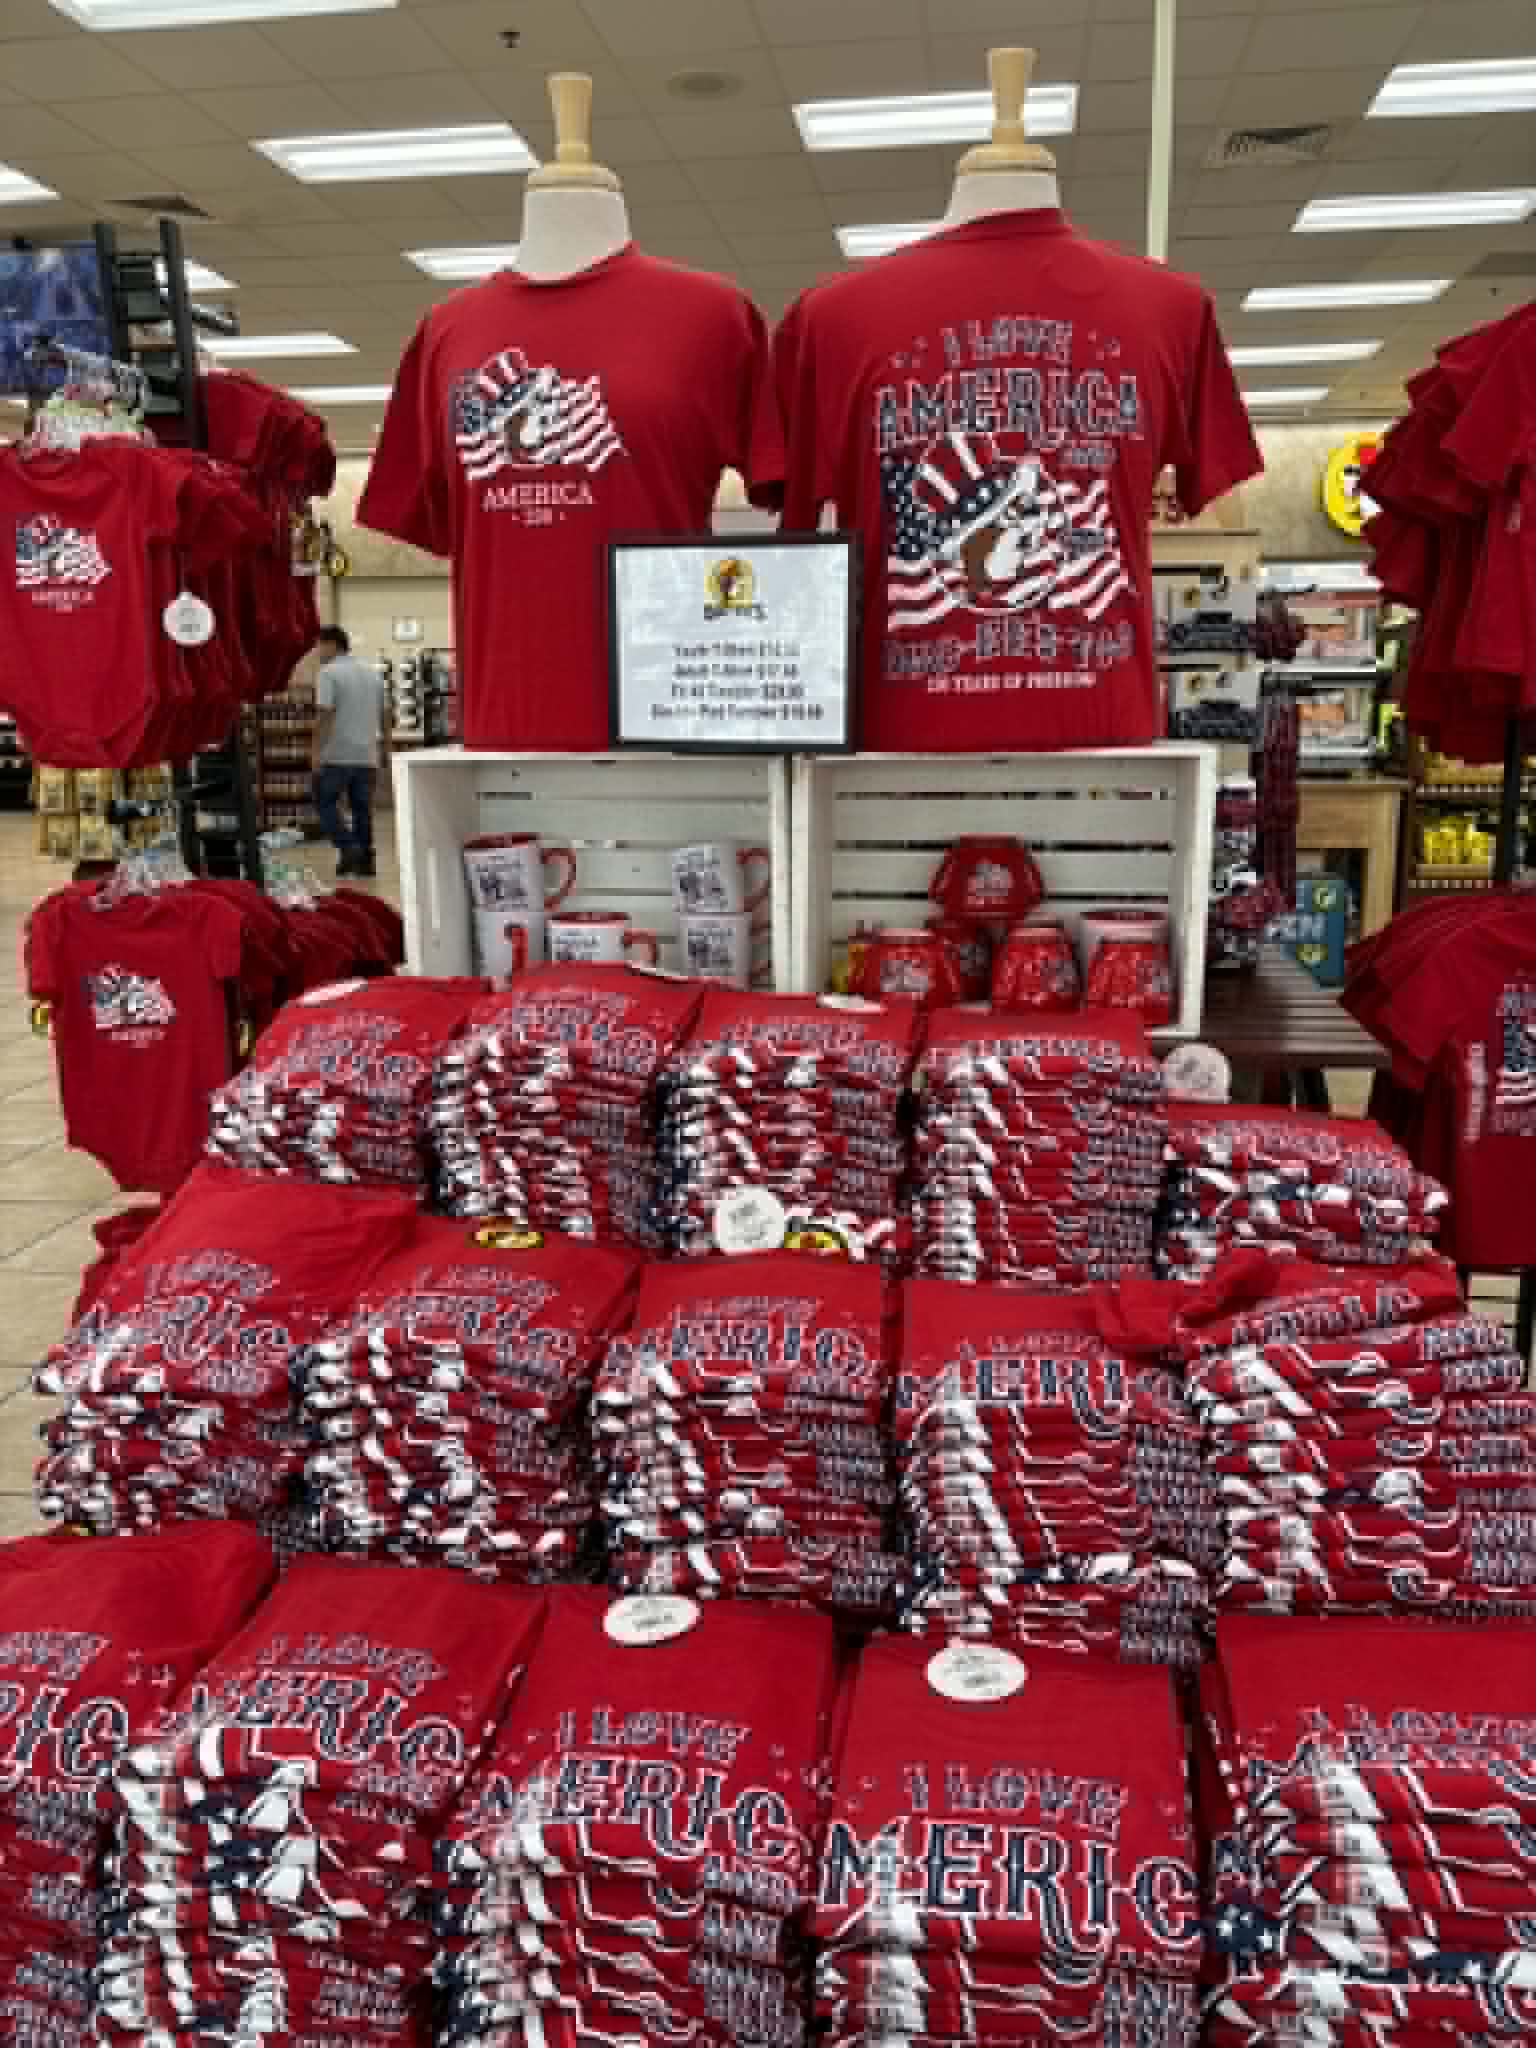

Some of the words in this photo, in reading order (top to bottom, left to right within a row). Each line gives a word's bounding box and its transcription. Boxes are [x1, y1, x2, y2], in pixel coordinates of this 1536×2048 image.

[968, 316, 1072, 365] LOVE
[874, 367, 1144, 453] AMERICA
[482, 482, 595, 510] AMERICA
[590, 1708, 752, 1764] LOVE
[945, 1763, 1127, 1840] LOVE
